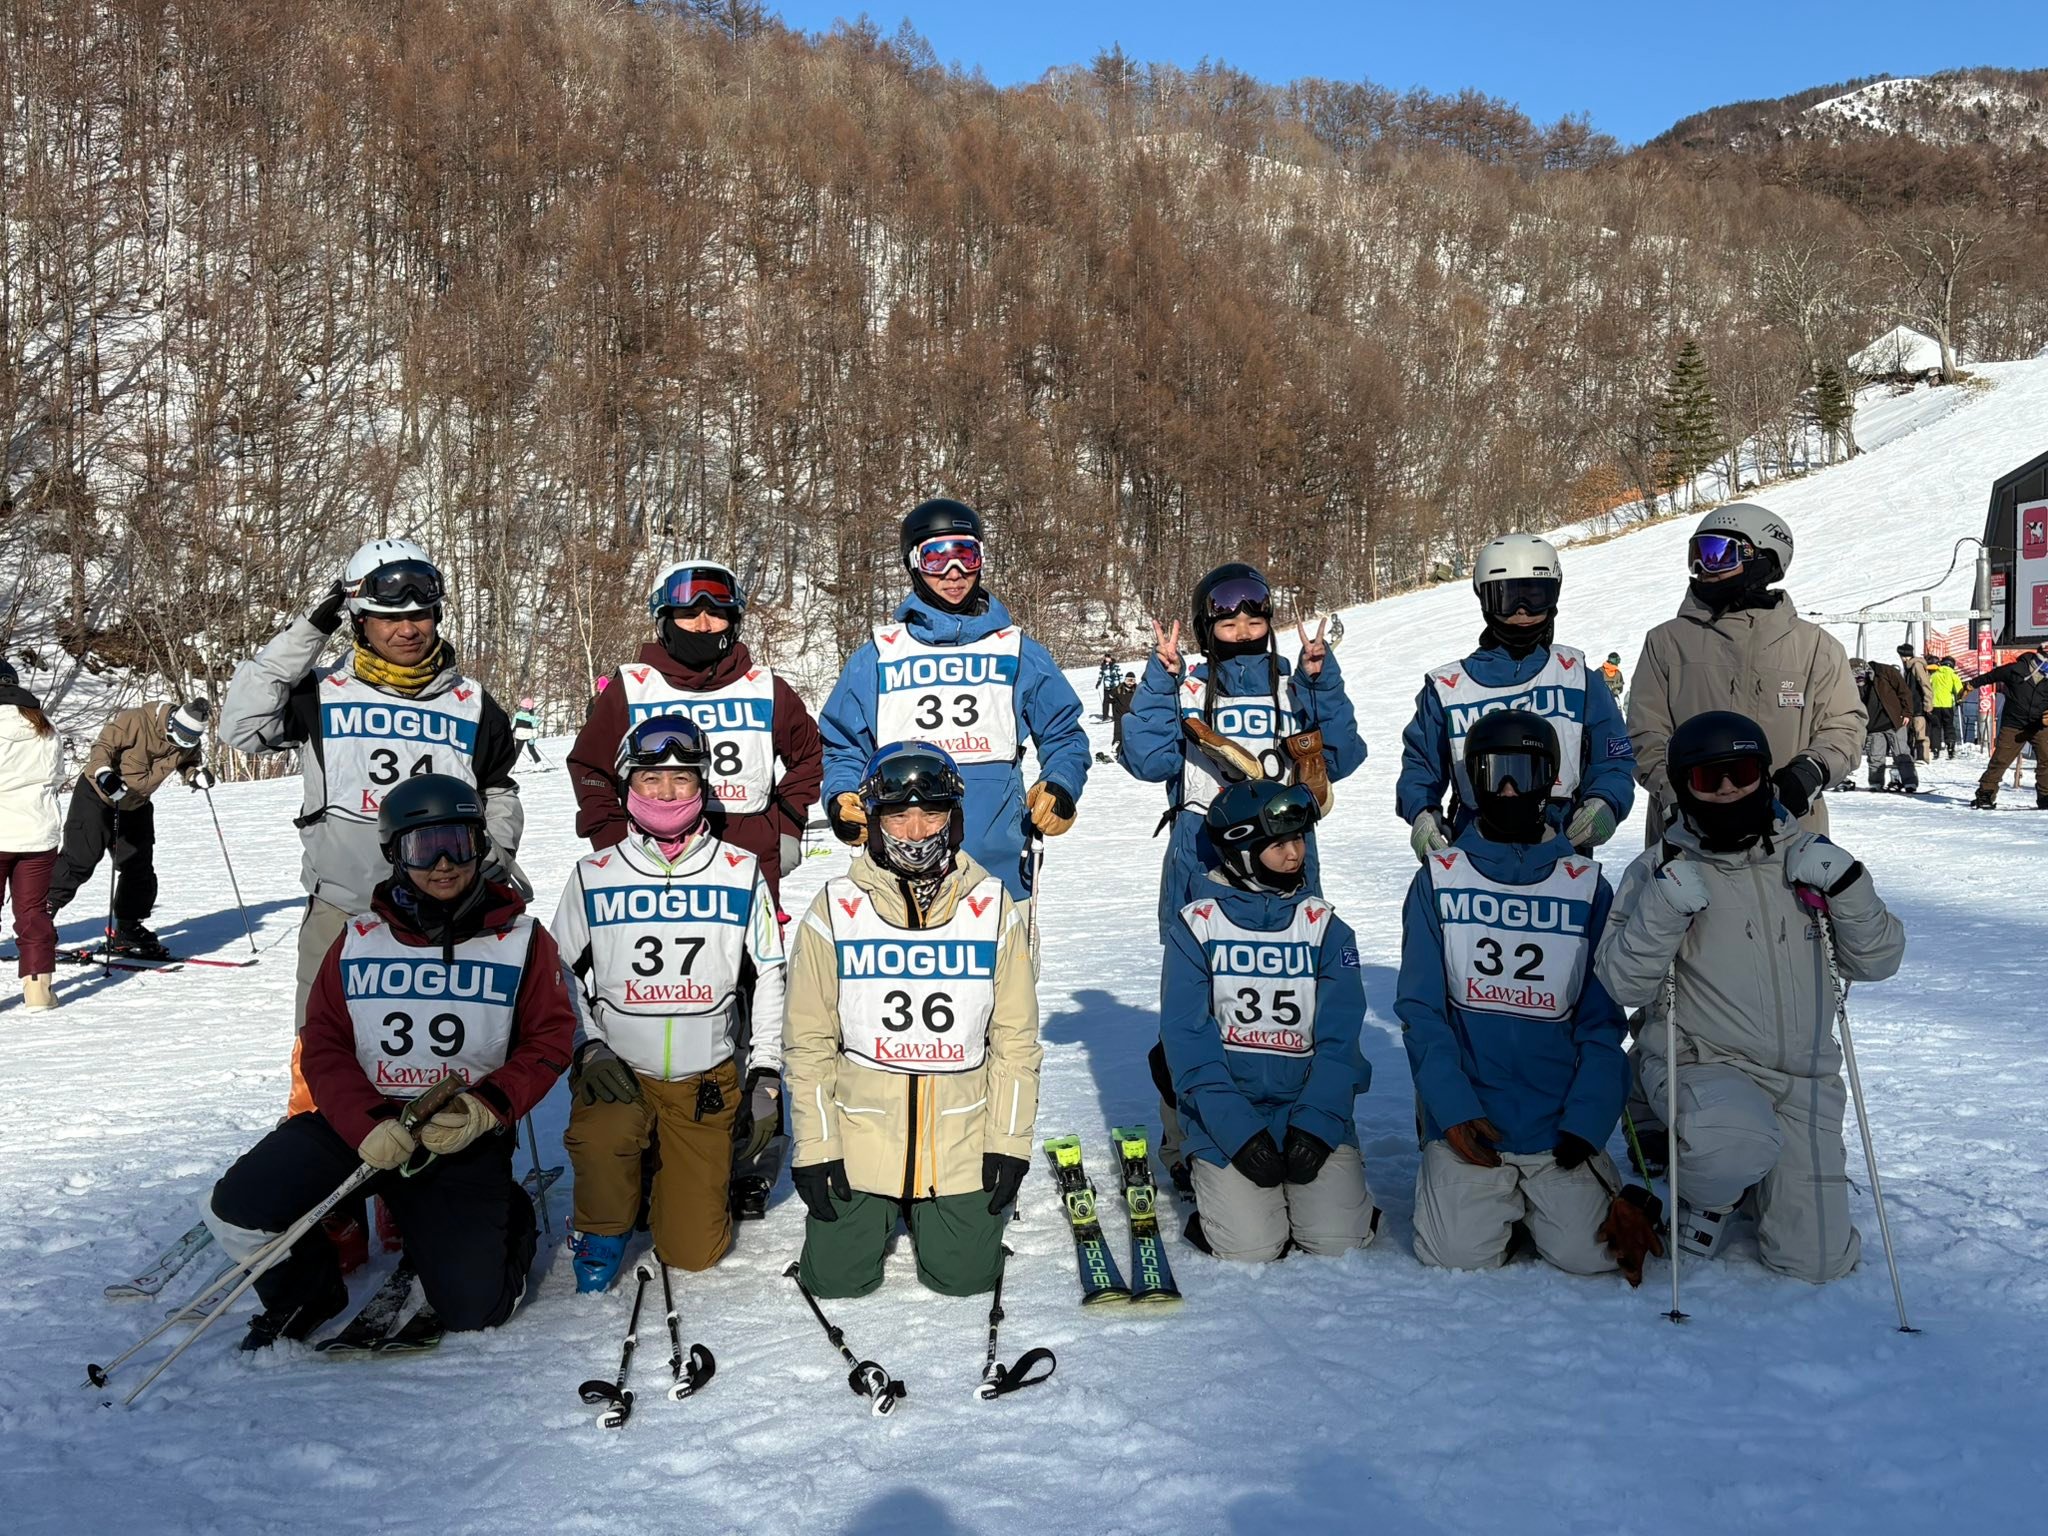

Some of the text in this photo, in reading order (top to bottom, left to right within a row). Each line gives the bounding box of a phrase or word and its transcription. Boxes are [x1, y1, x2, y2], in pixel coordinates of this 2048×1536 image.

[885, 656, 1006, 691] MOGUL
[329, 706, 467, 750] MOGUL
[914, 693, 979, 730] 33
[1188, 709, 1301, 737] OGUL
[713, 740, 743, 776] 8
[911, 732, 990, 750] waba
[368, 748, 433, 786] 34
[593, 889, 740, 922] MOGUL
[1440, 893, 1585, 933] MOGUL
[631, 936, 706, 977] 37
[843, 944, 990, 976] MOGUL
[1473, 937, 1544, 981] 32
[347, 963, 508, 1001] MOGUL
[624, 979, 713, 1001] Kawaba
[1466, 977, 1556, 1009] Kawaba
[881, 990, 955, 1033] 36
[1235, 987, 1301, 1026] 35
[380, 1012, 465, 1057] 39
[874, 1037, 965, 1060] Kawaba
[1226, 1025, 1304, 1048] Kawaba
[1083, 1240, 1111, 1289] FISCHER
[1138, 1237, 1161, 1290] FISCHER
